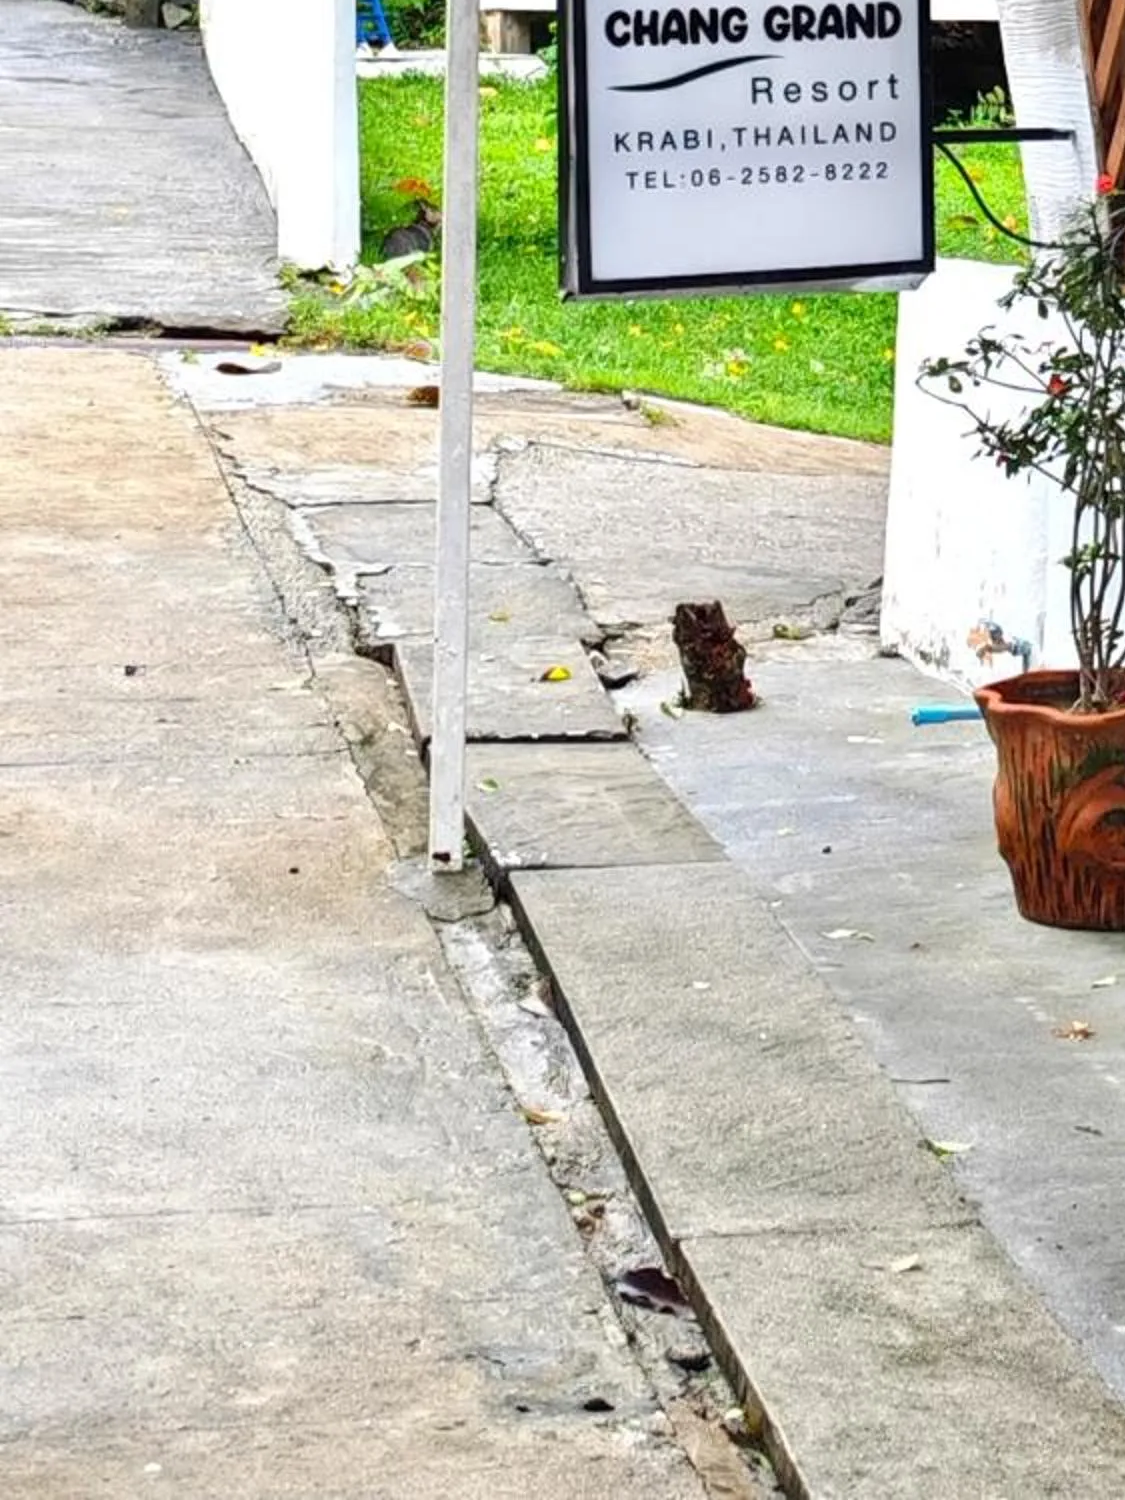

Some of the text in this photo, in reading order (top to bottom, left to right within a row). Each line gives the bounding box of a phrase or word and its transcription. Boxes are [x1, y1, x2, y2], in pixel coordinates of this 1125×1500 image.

[604, 1, 903, 48] CHANG GRAND
[751, 73, 900, 105] Resort
